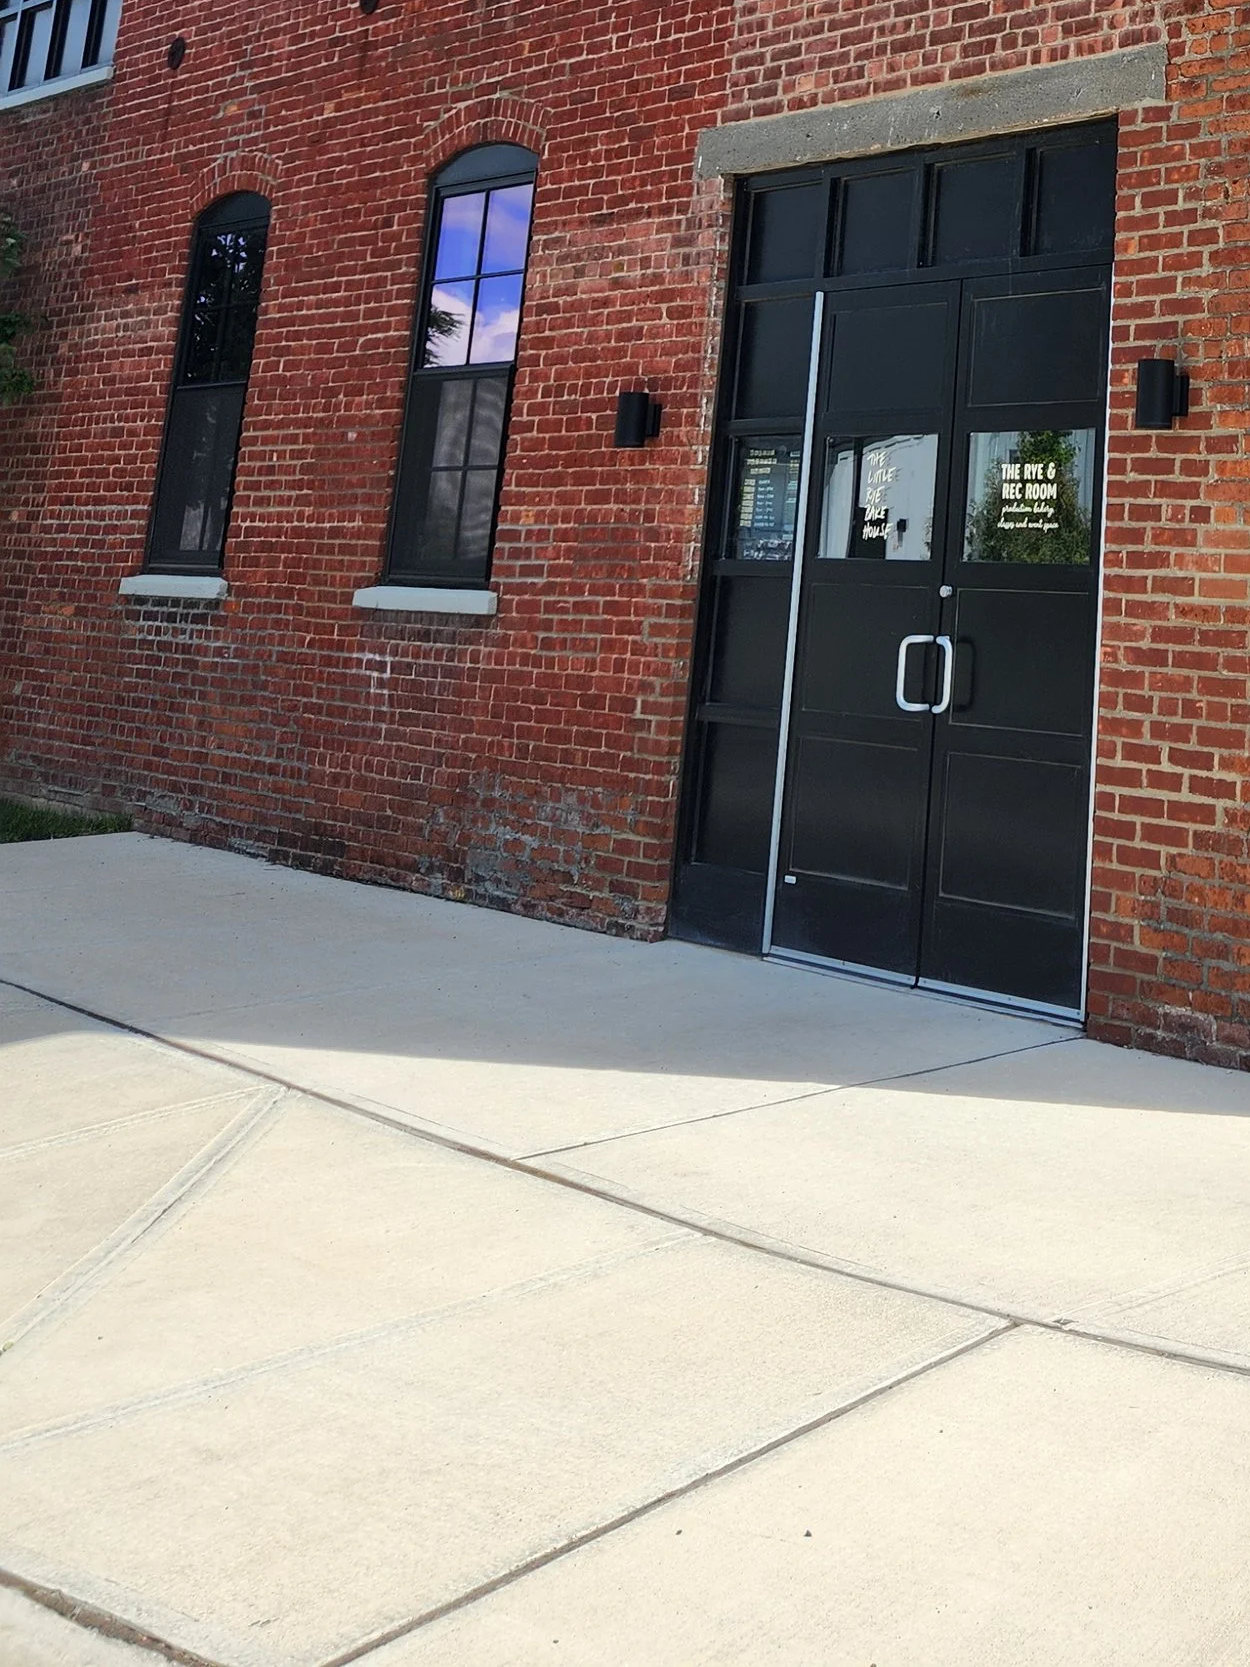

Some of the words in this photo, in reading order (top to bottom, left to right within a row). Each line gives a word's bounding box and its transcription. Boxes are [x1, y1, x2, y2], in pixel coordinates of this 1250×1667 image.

[867, 451, 887, 467] THE
[868, 466, 897, 484] LITTLE
[1001, 463, 1021, 480] THE
[1023, 463, 1044, 480] RYE
[1047, 462, 1056, 480] &
[866, 485, 886, 505] RYE
[1002, 482, 1023, 500] REC
[1024, 482, 1057, 500] ROOM
[864, 504, 888, 521] BAKE
[1001, 501, 1033, 517] production
[862, 521, 894, 540] HOUSE
[1015, 516, 1028, 528] and
[1028, 518, 1043, 528] event
[1043, 522, 1060, 533] space
